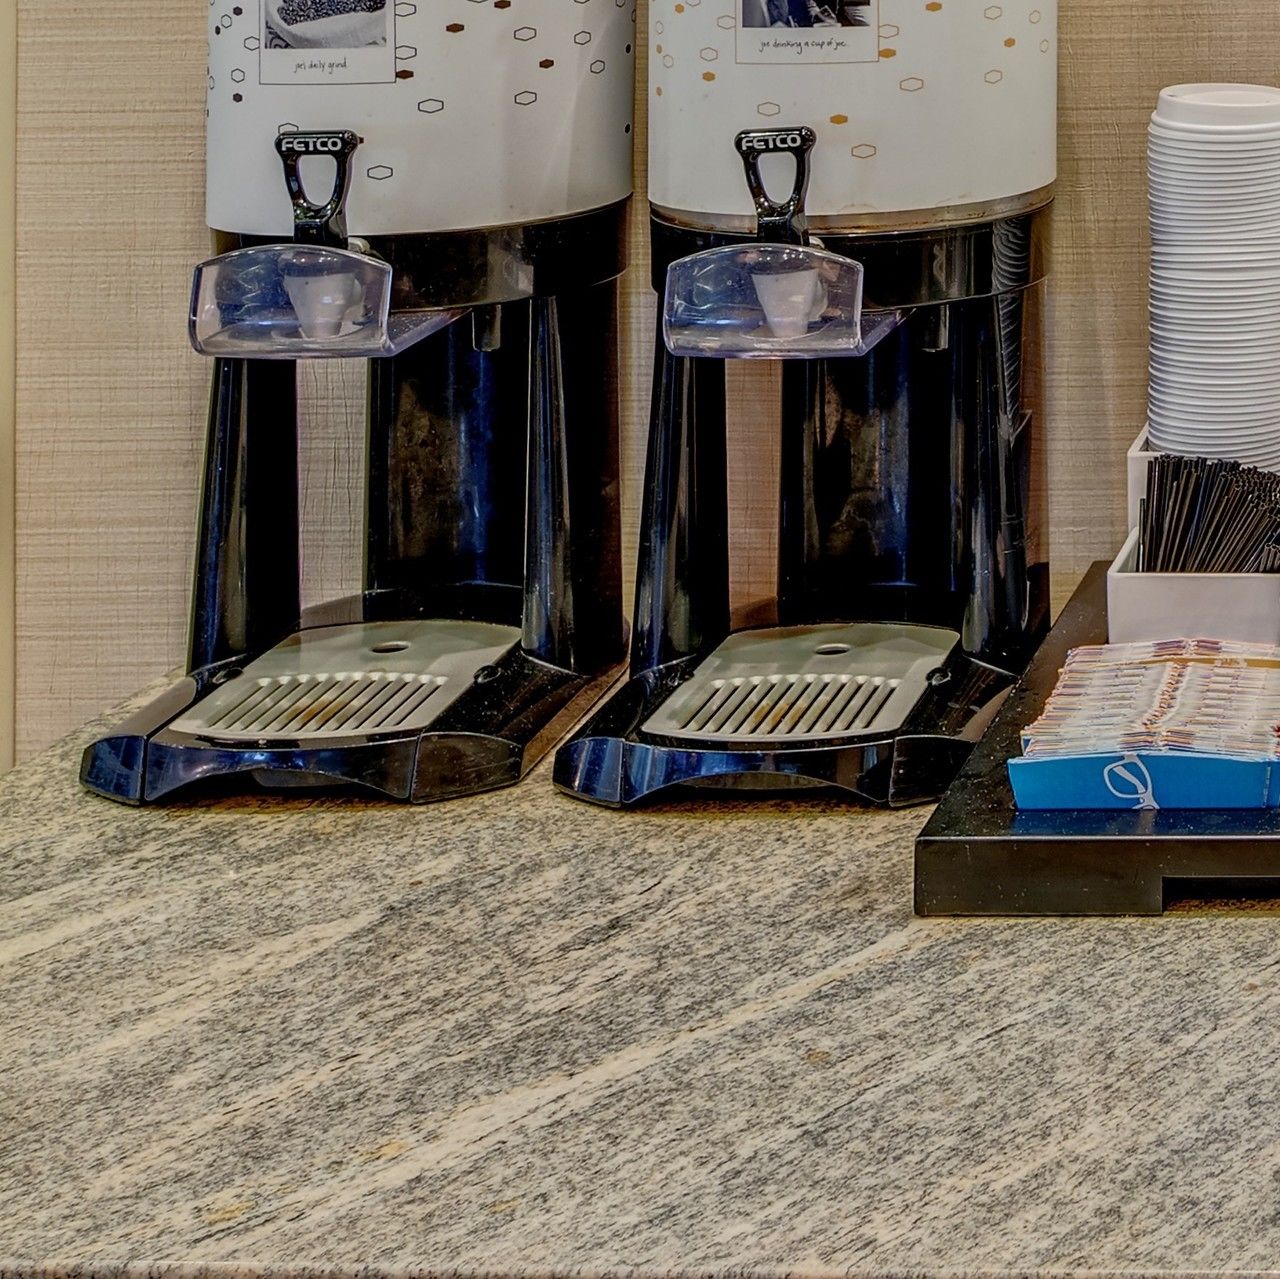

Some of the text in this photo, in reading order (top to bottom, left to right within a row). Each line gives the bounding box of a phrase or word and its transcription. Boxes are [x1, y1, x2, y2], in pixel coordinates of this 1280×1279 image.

[327, 57, 347, 74] grind
[281, 137, 342, 151] FETCO
[741, 134, 802, 151] FETCO
